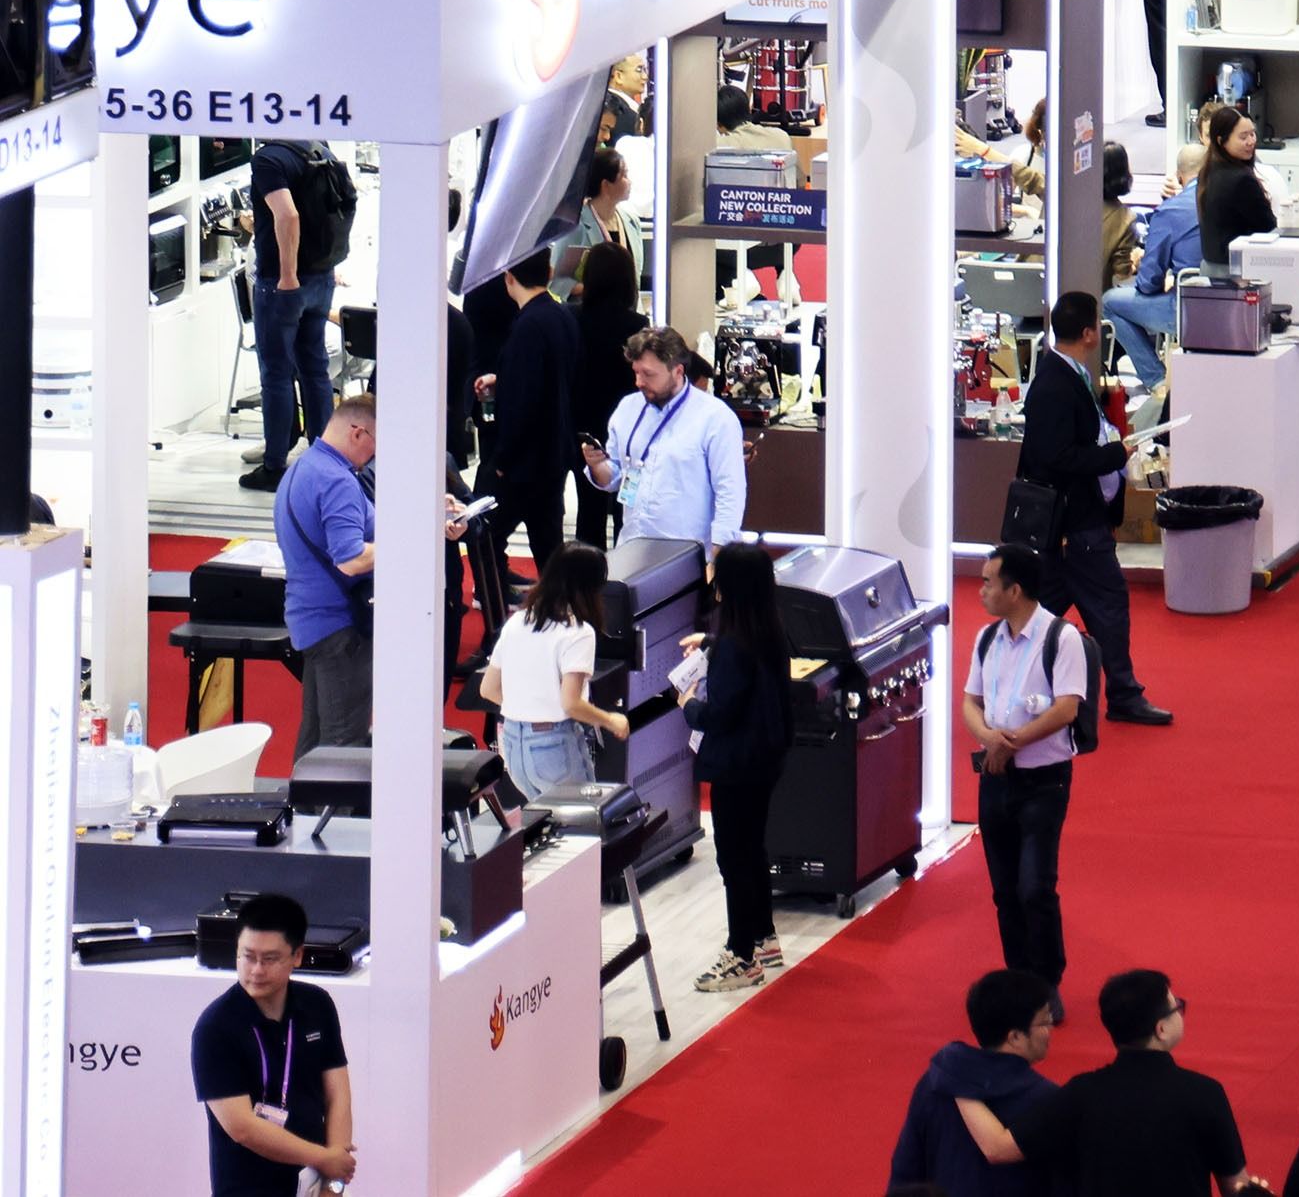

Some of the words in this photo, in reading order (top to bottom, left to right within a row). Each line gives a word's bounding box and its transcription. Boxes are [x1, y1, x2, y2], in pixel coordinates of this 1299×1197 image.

[101, 87, 193, 122] 5-36
[209, 90, 353, 127] E13-14
[719, 200, 746, 212] NEW
[746, 202, 812, 215] COLLECTION
[720, 189, 766, 202] CANTON
[768, 191, 792, 204] FAIR
[506, 975, 552, 1024] Kangye
